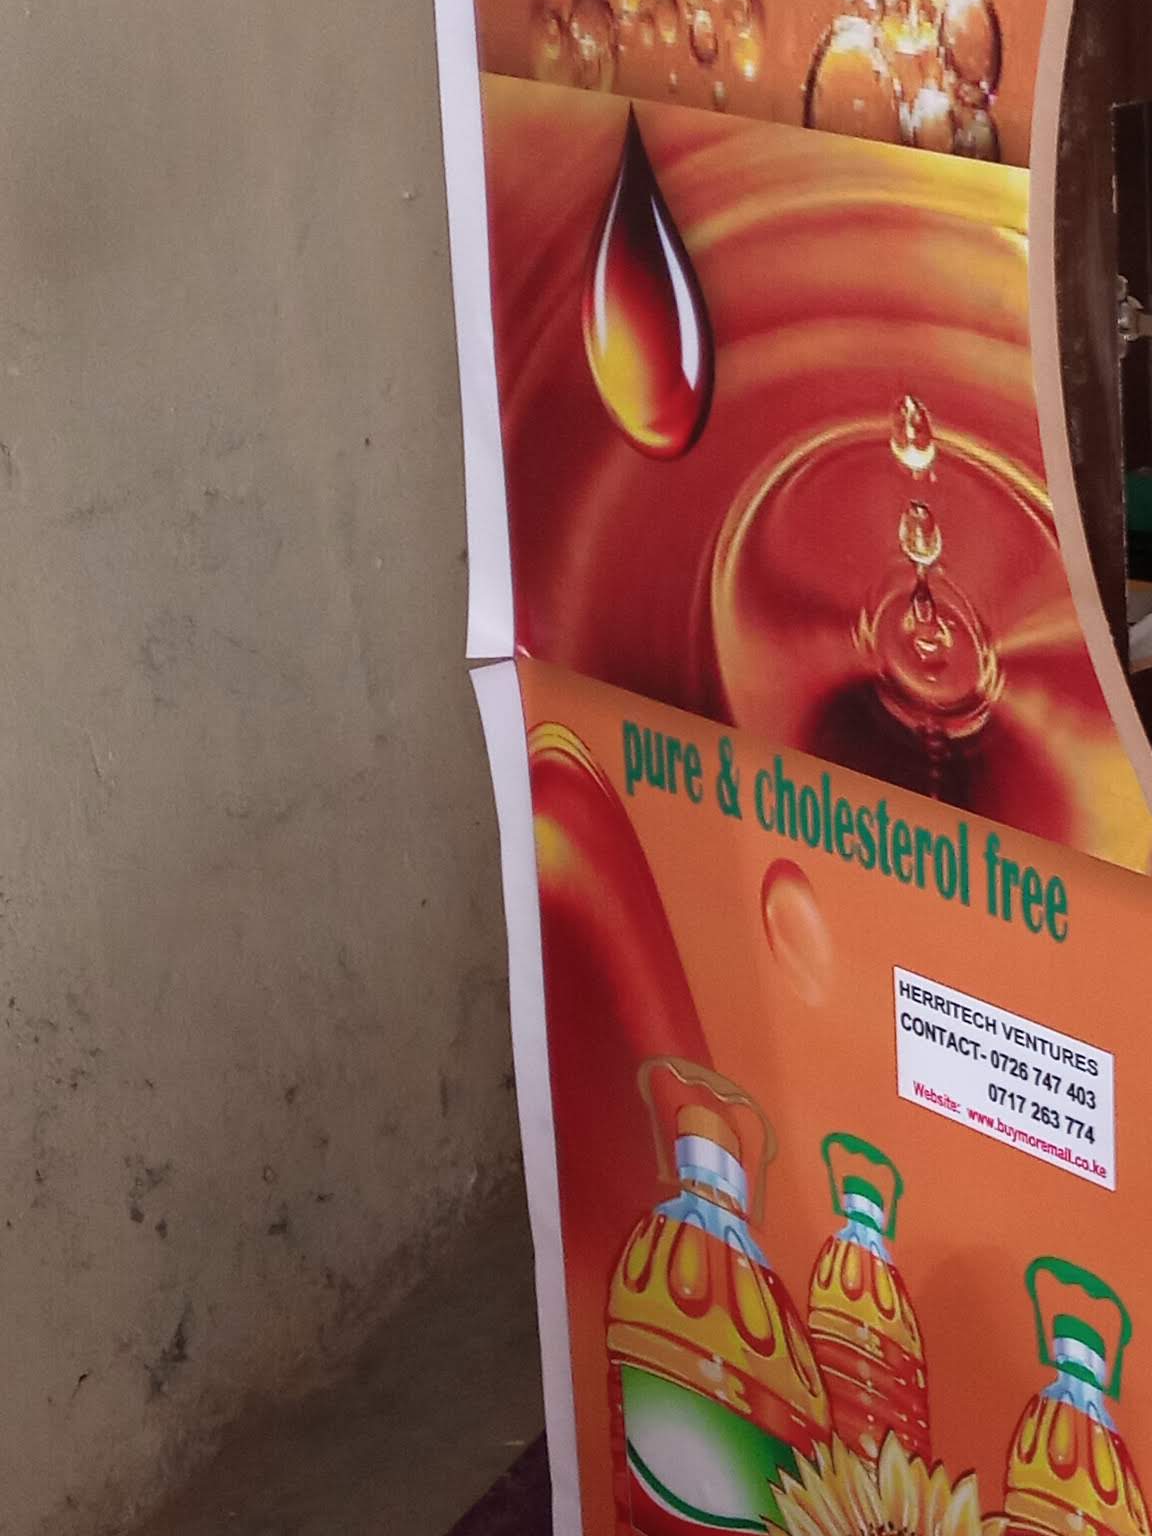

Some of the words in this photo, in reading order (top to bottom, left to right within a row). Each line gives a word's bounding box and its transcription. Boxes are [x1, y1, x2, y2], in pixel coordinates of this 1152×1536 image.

[622, 720, 704, 805] pure
[716, 736, 742, 820] &
[754, 754, 970, 908] cholesterol
[984, 831, 1069, 944] free
[899, 980, 997, 1035] HERRITECH
[1001, 1022, 1099, 1077] VENTURES
[900, 1012, 988, 1061] CONTACT-
[990, 1050, 1029, 1081] 0726
[1033, 1067, 1062, 1095] 747
[1066, 1082, 1097, 1110] 403
[913, 1080, 961, 1114] Website:
[988, 1083, 1027, 1114] 0717
[1031, 1102, 1061, 1129] 263
[1065, 1115, 1097, 1145] 774
